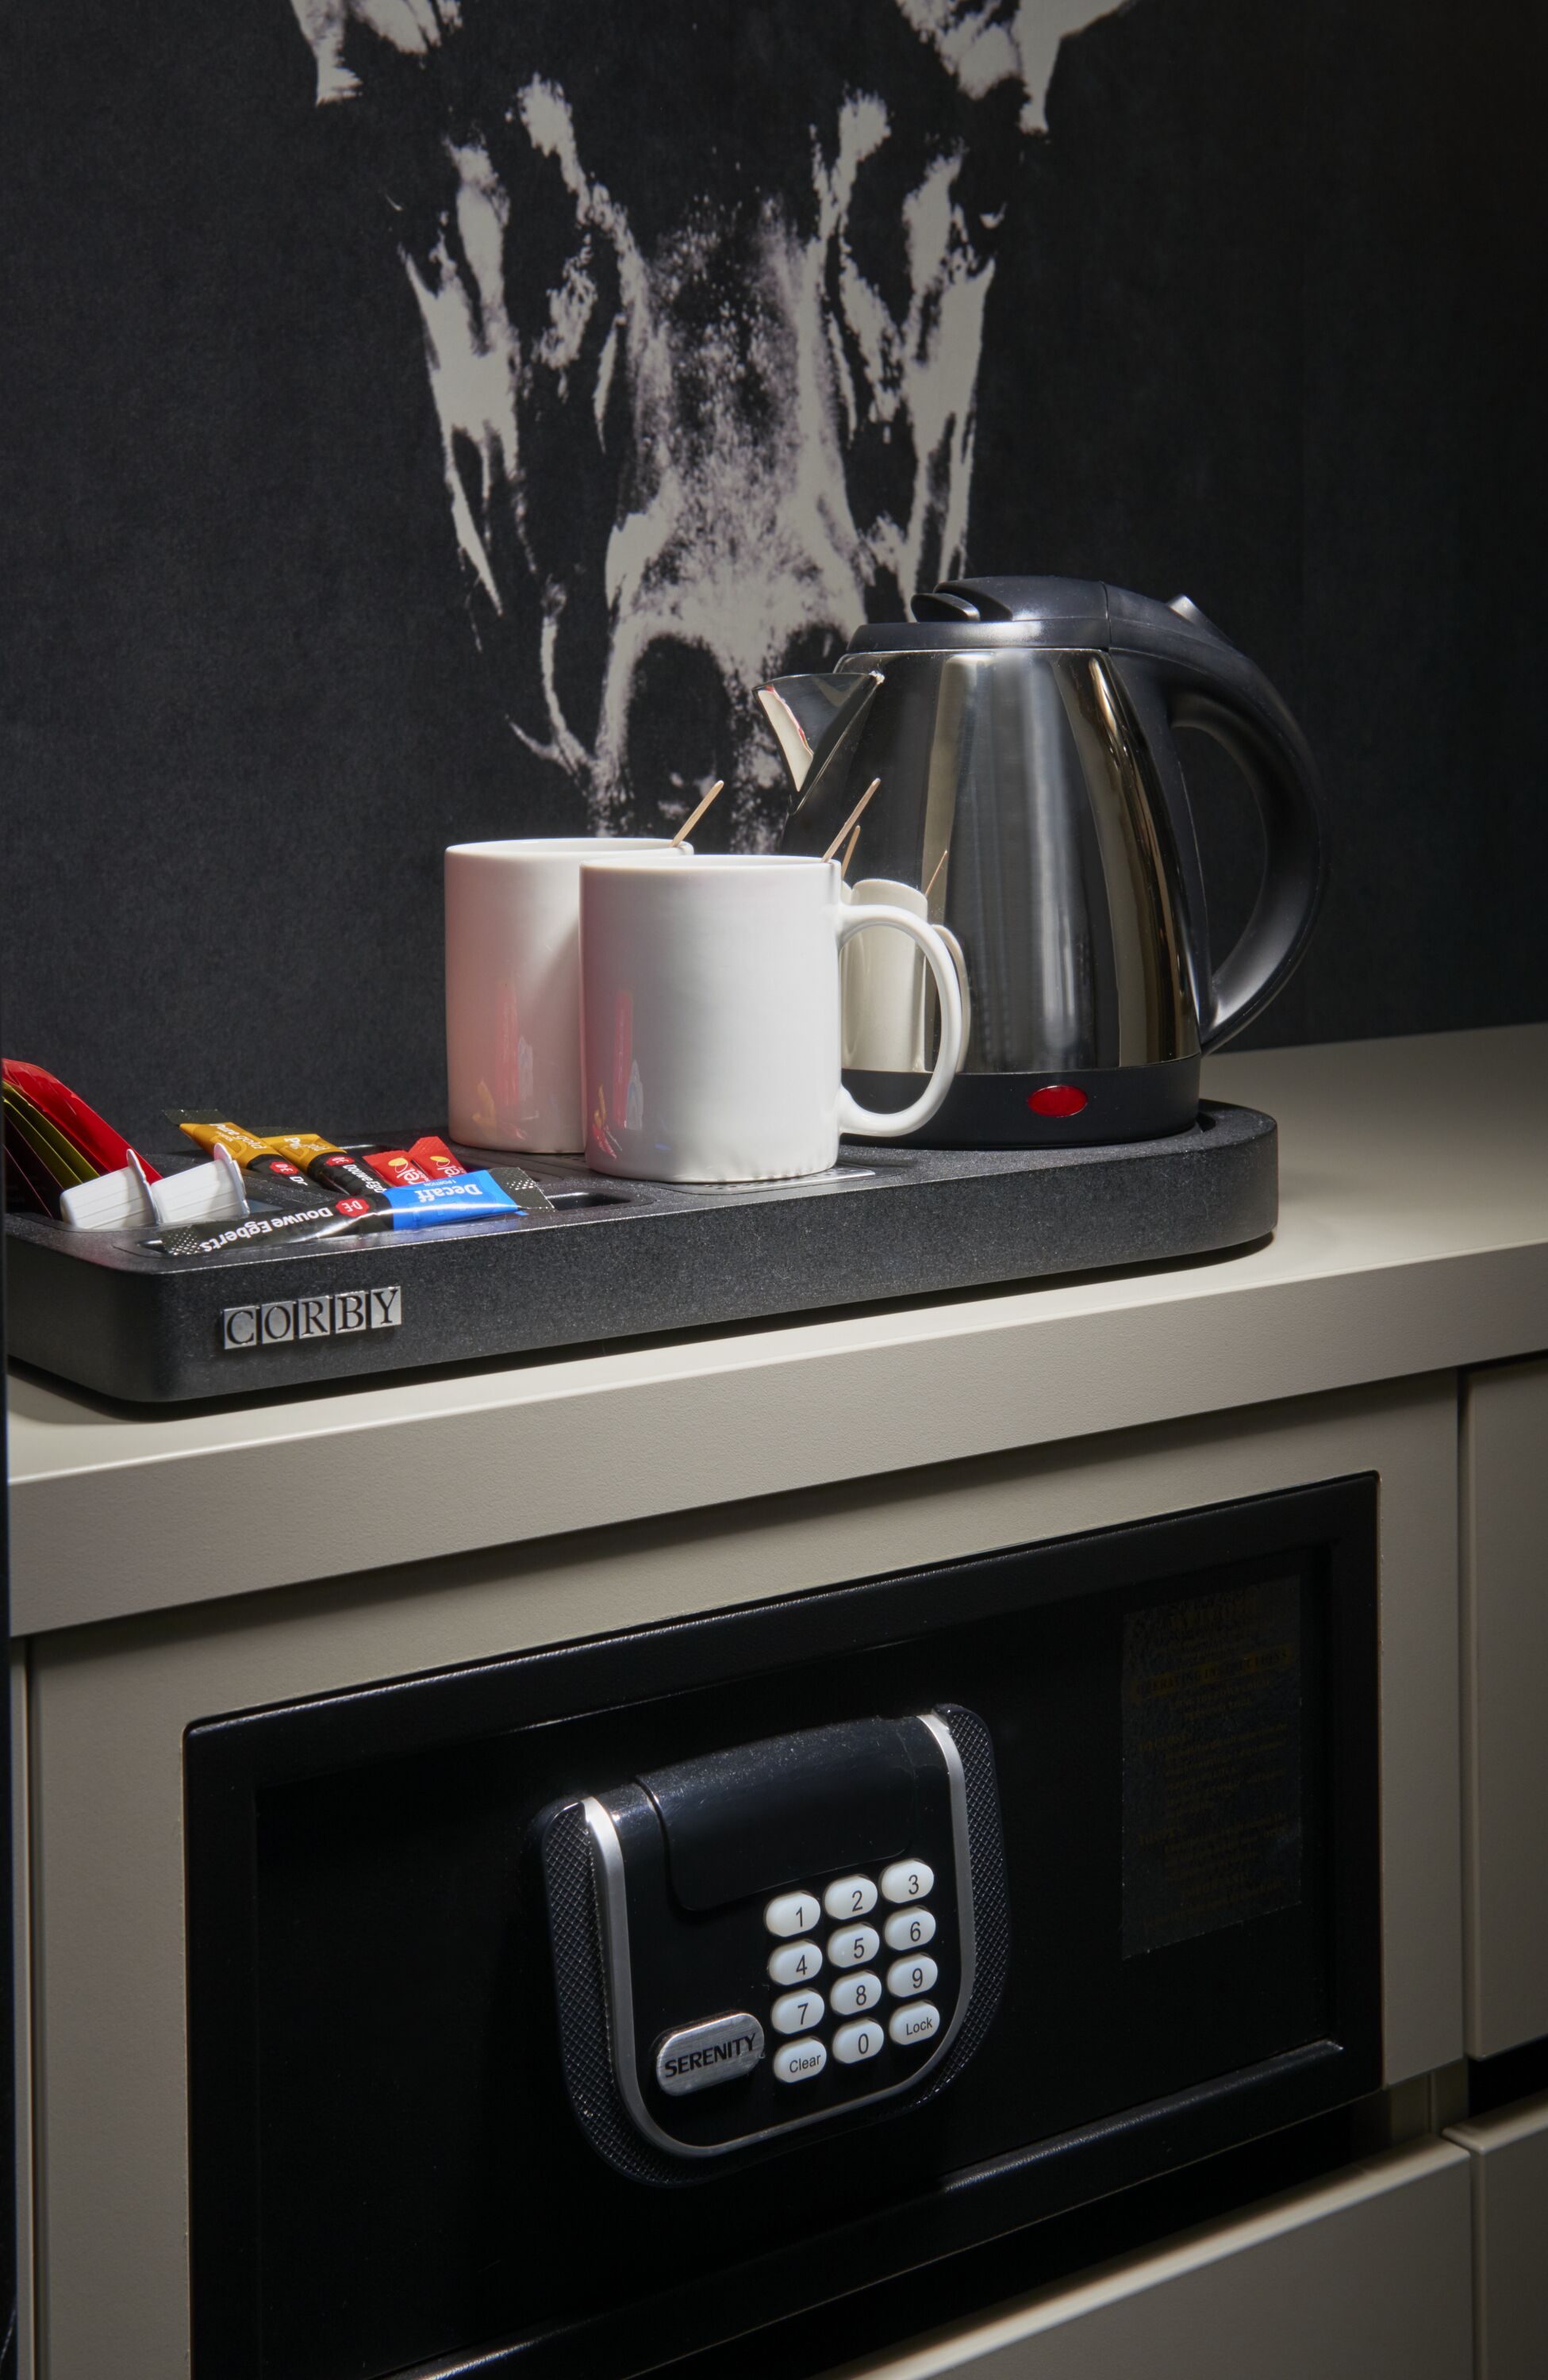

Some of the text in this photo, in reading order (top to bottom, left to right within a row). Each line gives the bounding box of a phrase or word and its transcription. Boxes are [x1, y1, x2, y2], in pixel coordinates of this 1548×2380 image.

[413, 1184, 483, 1203] Decaff
[199, 1207, 334, 1253] Douwe Egberts
[226, 1288, 399, 1345] CORBY
[908, 1875, 920, 1895] 3
[852, 1891, 863, 1912] 2
[796, 1907, 805, 1928] 1
[910, 1921, 921, 1942] 6
[854, 1938, 865, 1959] 5
[796, 1955, 808, 1976] 4
[912, 1967, 924, 1989] 9
[855, 1985, 867, 2006] 8
[797, 2003, 809, 2025] 7
[905, 2017, 934, 2036] Lock
[858, 2033, 870, 2055] 0
[664, 2033, 757, 2079] SERENITY
[789, 2054, 821, 2074] Clear
